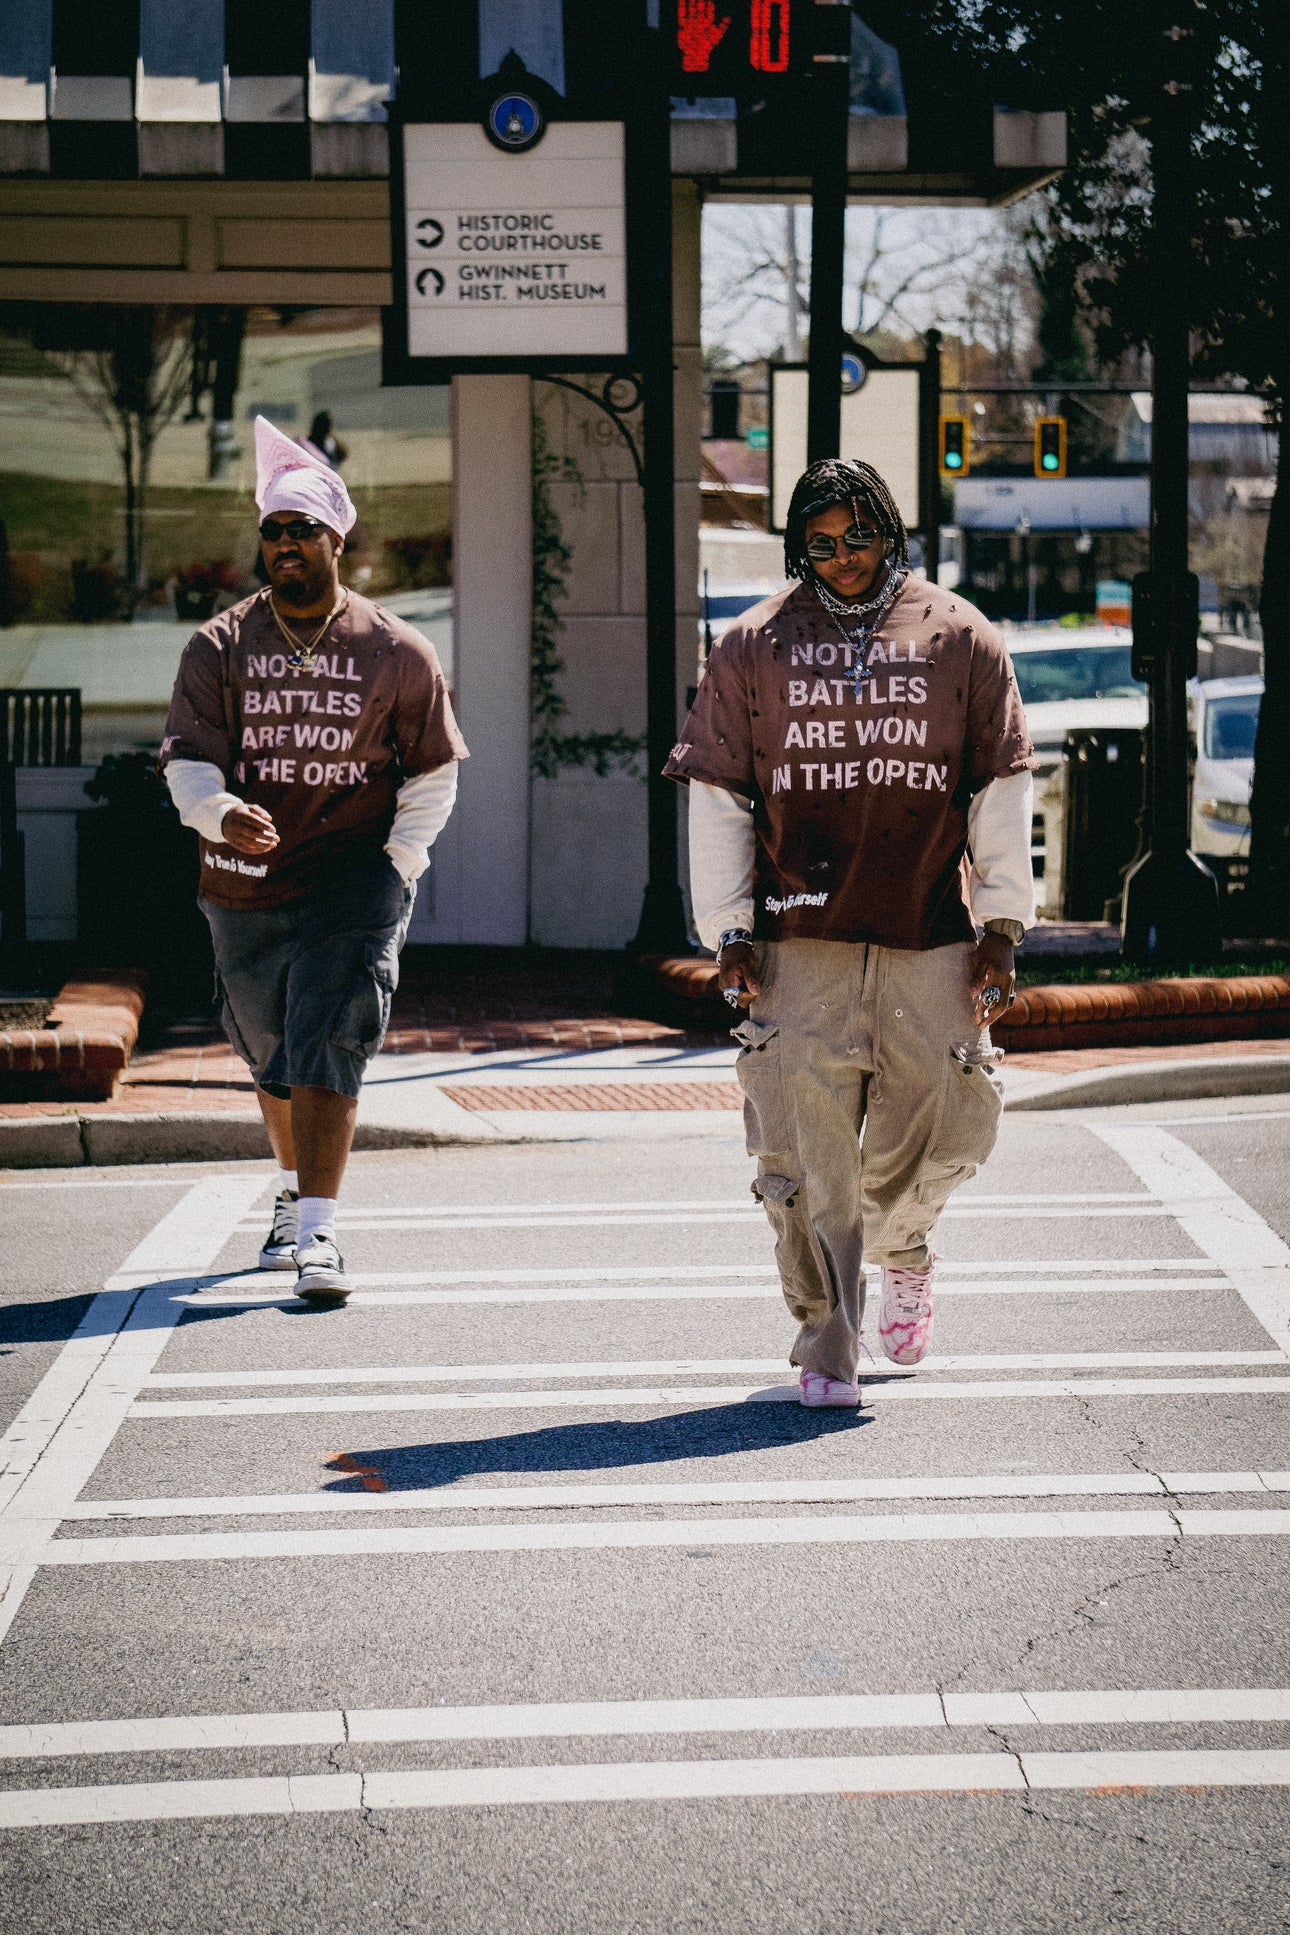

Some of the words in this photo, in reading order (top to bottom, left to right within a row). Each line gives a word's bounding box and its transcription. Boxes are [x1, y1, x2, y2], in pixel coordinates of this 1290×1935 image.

[457, 215, 554, 232] HISTORIC
[457, 234, 603, 251] COURTHOUSE
[458, 264, 568, 281] GWINNETT
[458, 285, 507, 301] HIST.
[517, 284, 606, 301] MUSEUM
[791, 642, 858, 667] NOT
[866, 640, 927, 666] ALL
[312, 654, 363, 682] ALL
[244, 690, 362, 717] BATTLES
[788, 676, 928, 707] BATTLES
[293, 723, 358, 752] WON
[784, 720, 846, 749] ARE
[855, 717, 928, 747] WON
[253, 757, 297, 784] THE
[772, 764, 792, 795] IN
[800, 761, 861, 791] THE
[867, 757, 948, 792] OPEN
[765, 895, 783, 915] Stay
